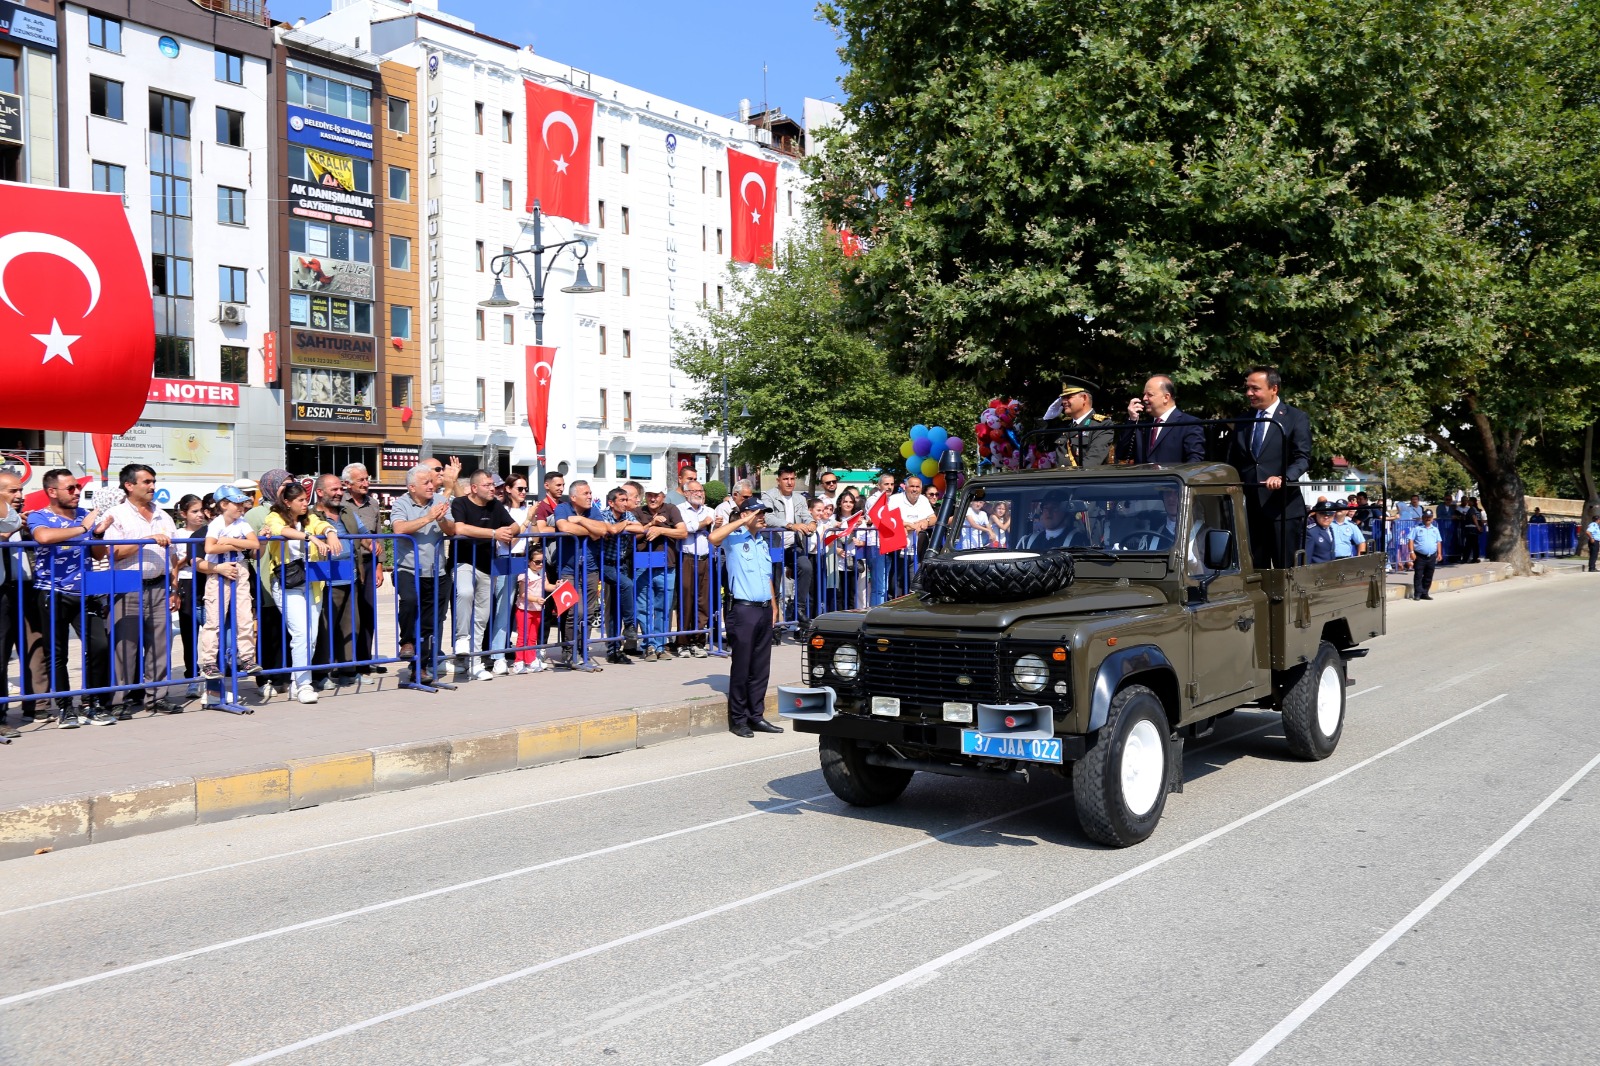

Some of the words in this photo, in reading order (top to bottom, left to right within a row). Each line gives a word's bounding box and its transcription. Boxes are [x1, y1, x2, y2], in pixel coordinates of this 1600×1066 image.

[304, 118, 341, 133] BELEDİYE-İŞ
[342, 126, 373, 140] SENDİKASI
[320, 132, 354, 144] KASTAMONU
[428, 95, 438, 179] OTEL
[291, 184, 306, 196] AK
[308, 186, 374, 208] DANIŞMANLIK
[296, 332, 372, 353] ŞAHTURAN
[166, 383, 234, 401] NOTER
[306, 406, 333, 418] ESEN
[974, 734, 991, 752] 37
[999, 739, 1025, 756] JAA
[1032, 740, 1059, 759] 022
